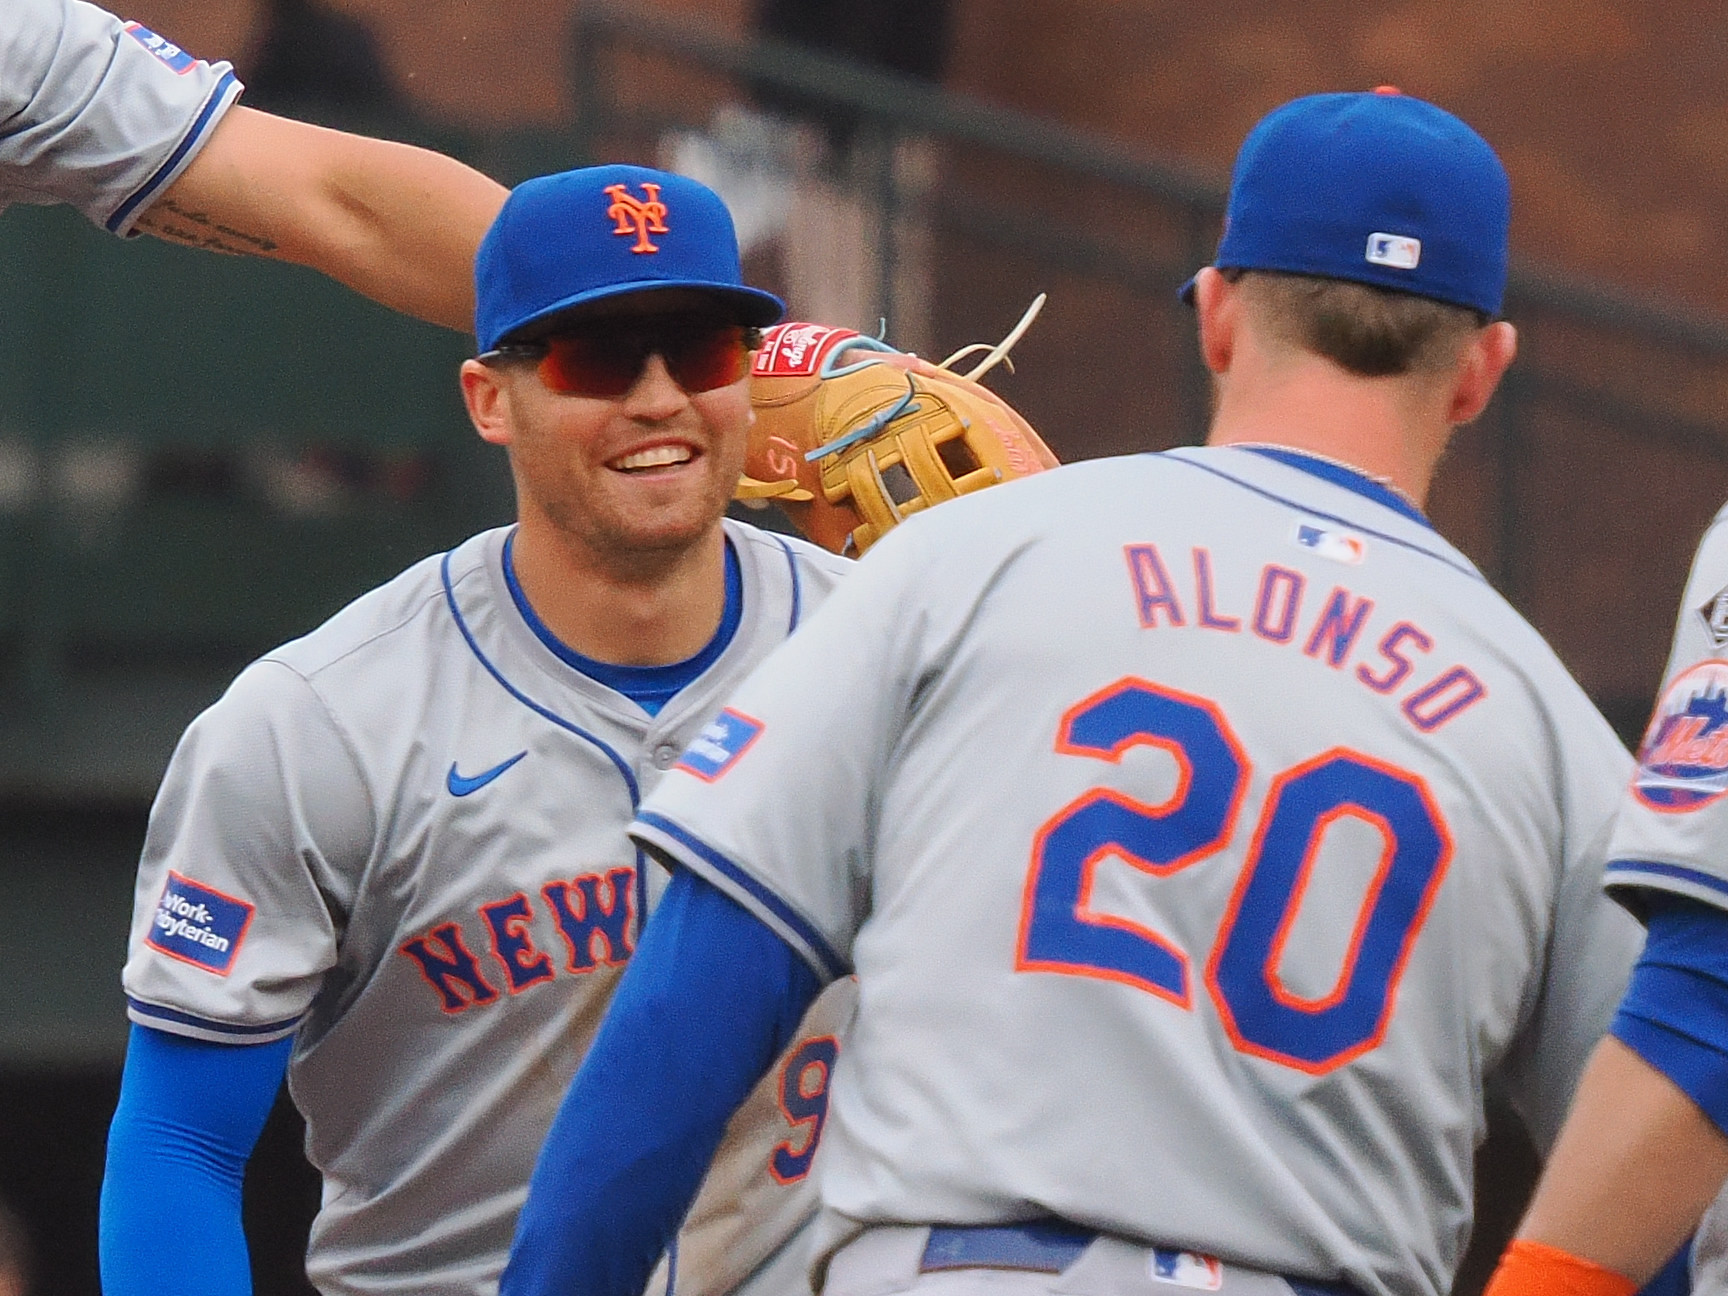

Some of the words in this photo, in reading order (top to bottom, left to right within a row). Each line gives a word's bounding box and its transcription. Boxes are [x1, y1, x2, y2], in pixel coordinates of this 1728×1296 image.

[1122, 543, 1487, 733] ALONSO
[400, 866, 636, 1015] NEW
[1014, 676, 1455, 1076] 20
[769, 1035, 840, 1185] 9
